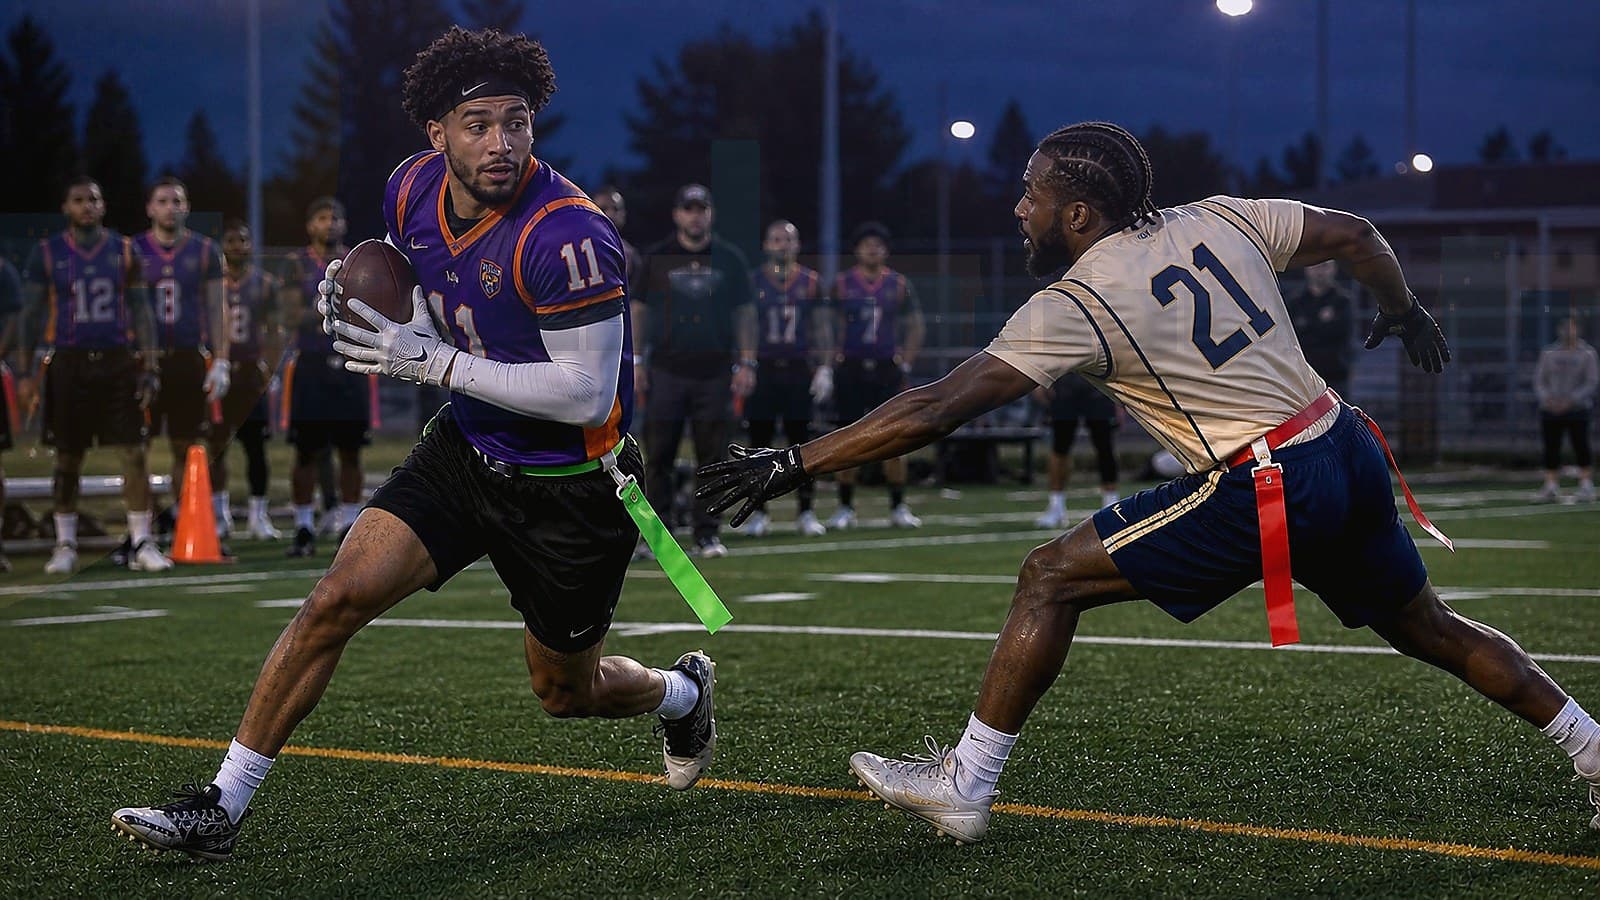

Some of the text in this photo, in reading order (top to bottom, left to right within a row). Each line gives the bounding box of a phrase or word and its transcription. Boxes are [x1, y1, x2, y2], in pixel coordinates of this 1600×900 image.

[560, 237, 604, 292] 11
[72, 277, 115, 323] 12
[427, 289, 488, 359] 11
[766, 304, 798, 344] 17
[861, 305, 882, 344] 7
[1151, 241, 1276, 373] 21
